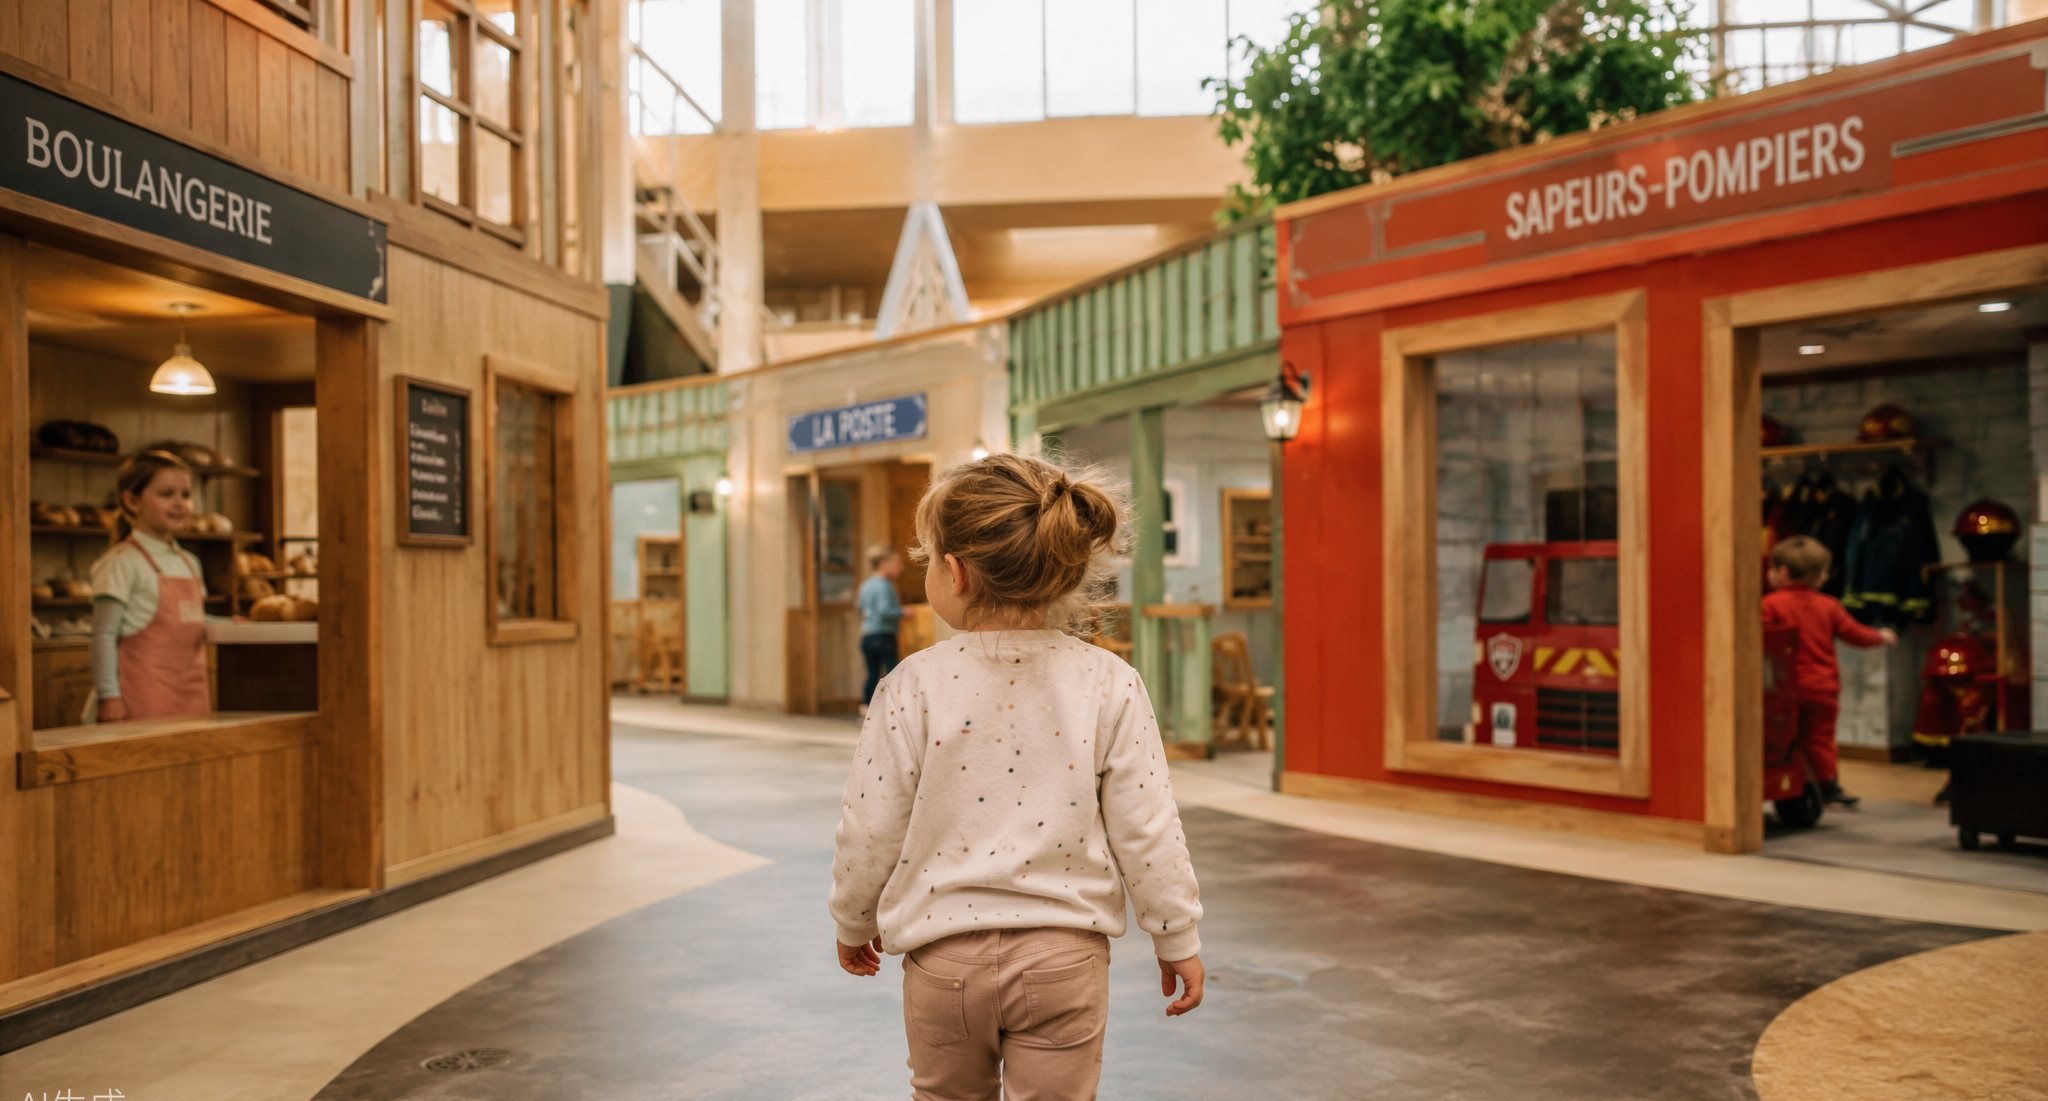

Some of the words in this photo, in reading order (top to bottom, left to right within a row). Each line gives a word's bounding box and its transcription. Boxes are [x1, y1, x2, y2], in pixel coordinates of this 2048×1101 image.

[25, 116, 272, 245] BOULANGERIE
[1505, 115, 1865, 240] SAPEURS-POMPIERS
[812, 414, 836, 447] LA
[838, 402, 897, 444] POSTE
